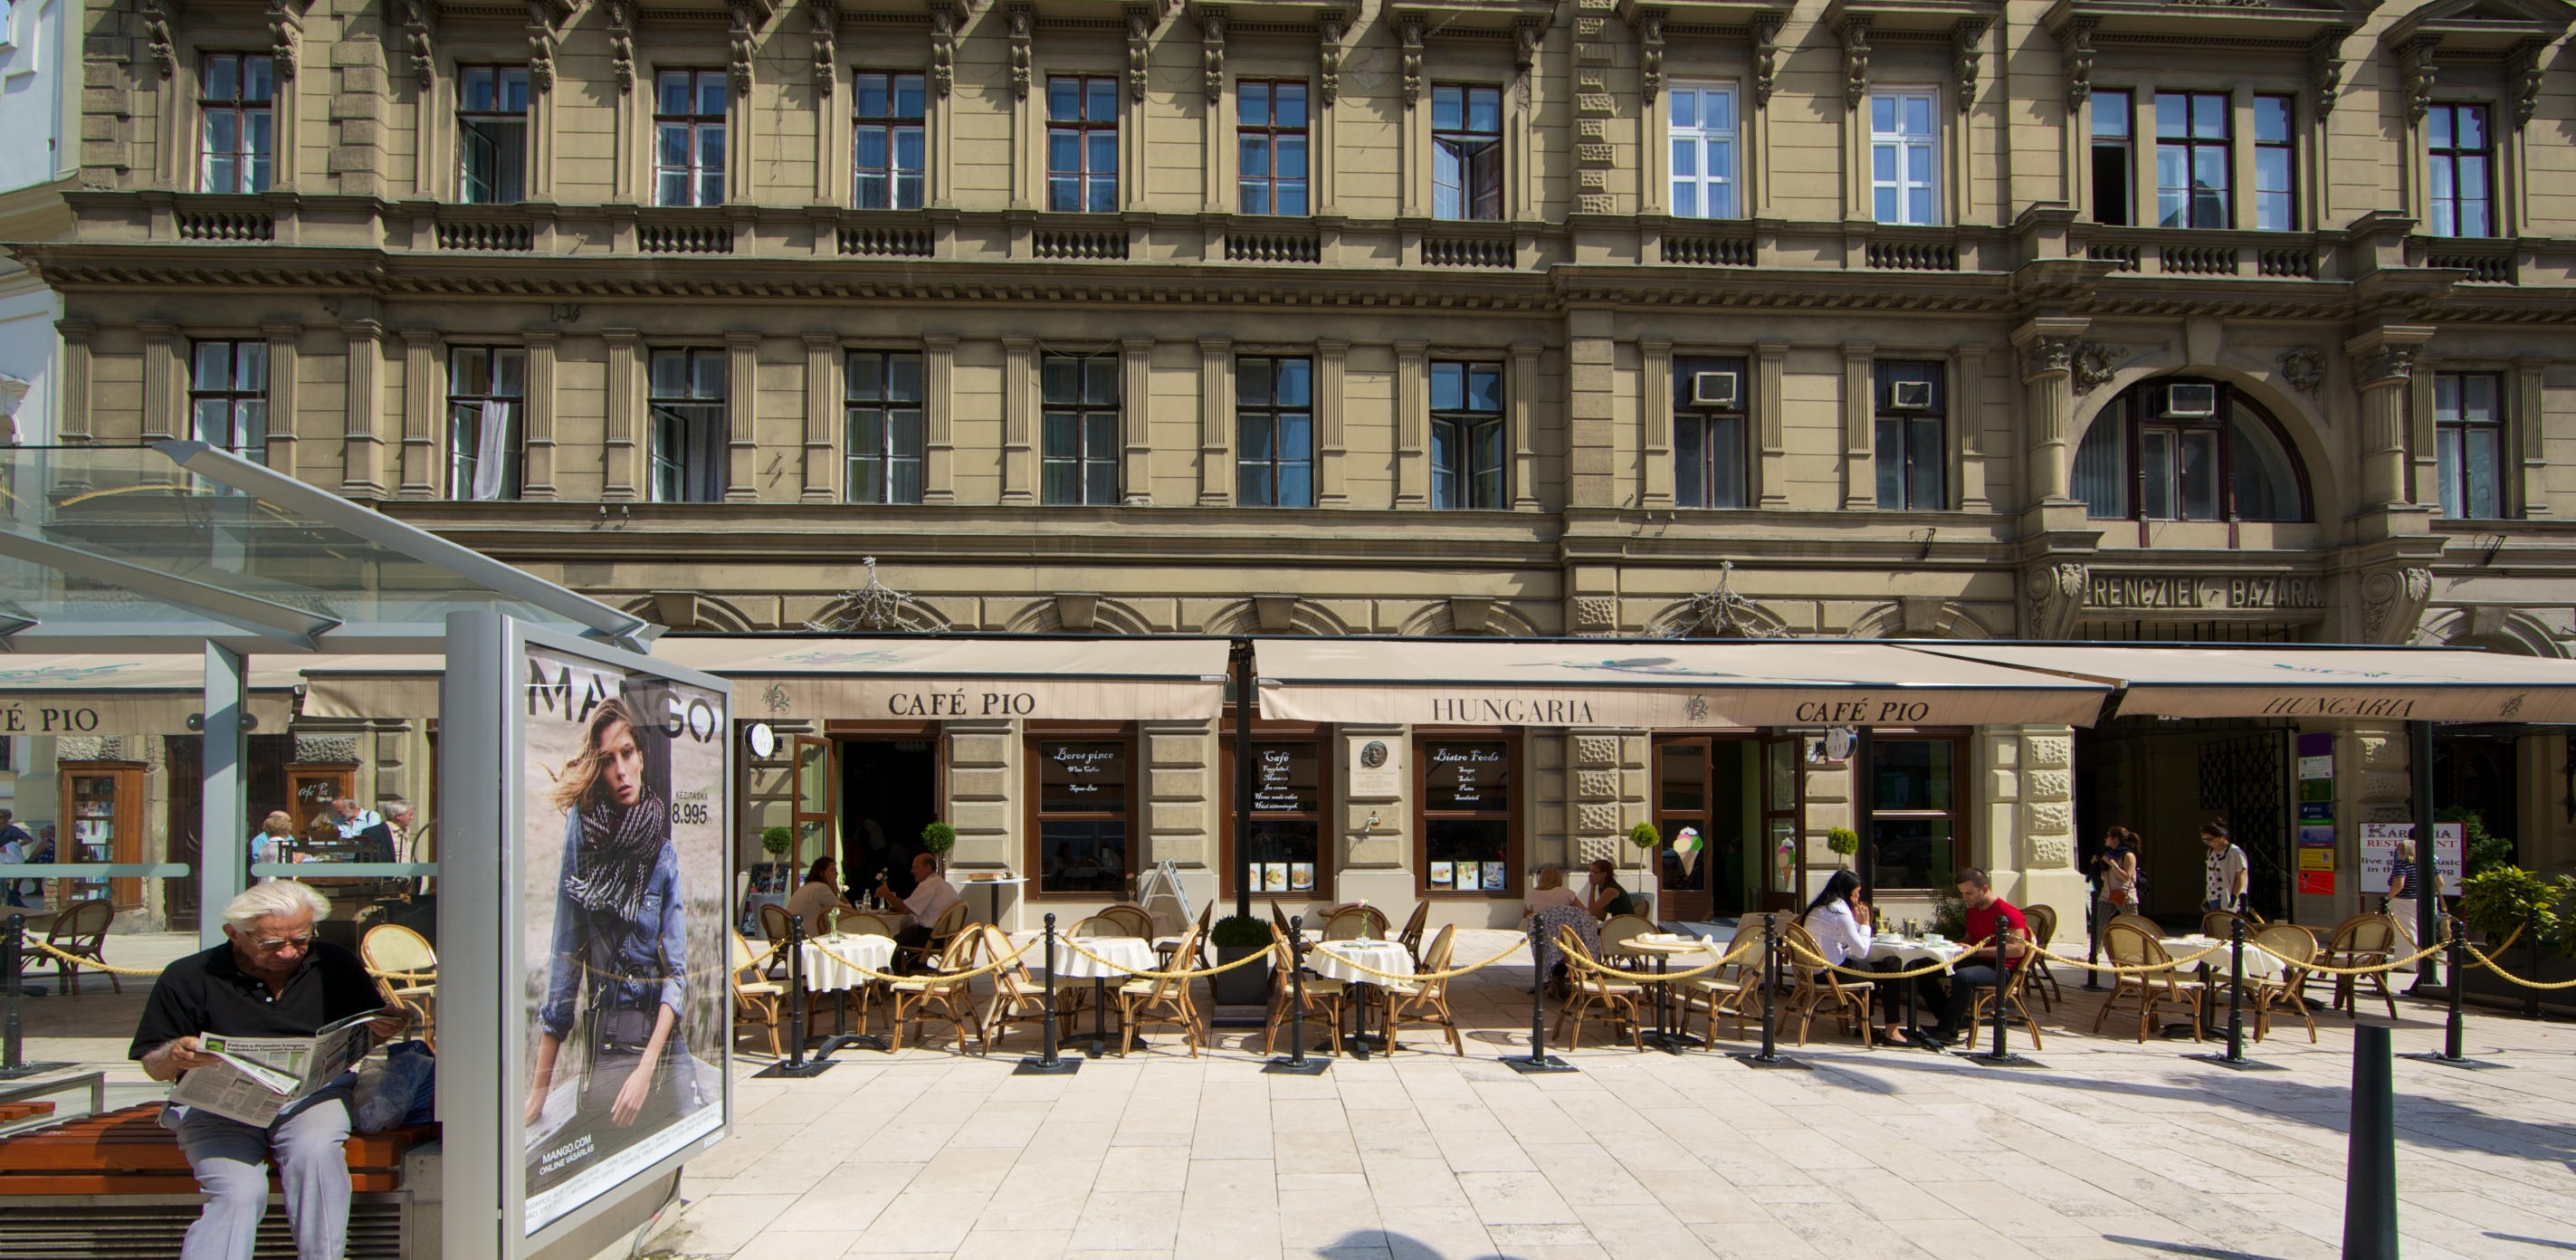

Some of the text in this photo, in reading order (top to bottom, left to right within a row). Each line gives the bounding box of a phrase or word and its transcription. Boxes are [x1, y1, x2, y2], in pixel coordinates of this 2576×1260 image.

[529, 659, 715, 744] MANGO
[889, 688, 1035, 716] CAFÉ PIO
[1431, 698, 1594, 723] HUNGARIA
[1796, 698, 1929, 721] CAFÉ PIO
[2261, 697, 2415, 718] HUNGARIA
[39, 708, 99, 731] PIO
[1054, 748, 1113, 764] Boros pince
[1264, 750, 1290, 765] Café
[1434, 748, 1499, 761] Bistro Foods
[673, 803, 707, 824] 8.995
[2367, 824, 2452, 838] KÁRIA
[2367, 839, 2457, 848] RESTNT
[542, 1133, 592, 1164] MANGO.COM
[539, 1158, 566, 1176] ONLINE
